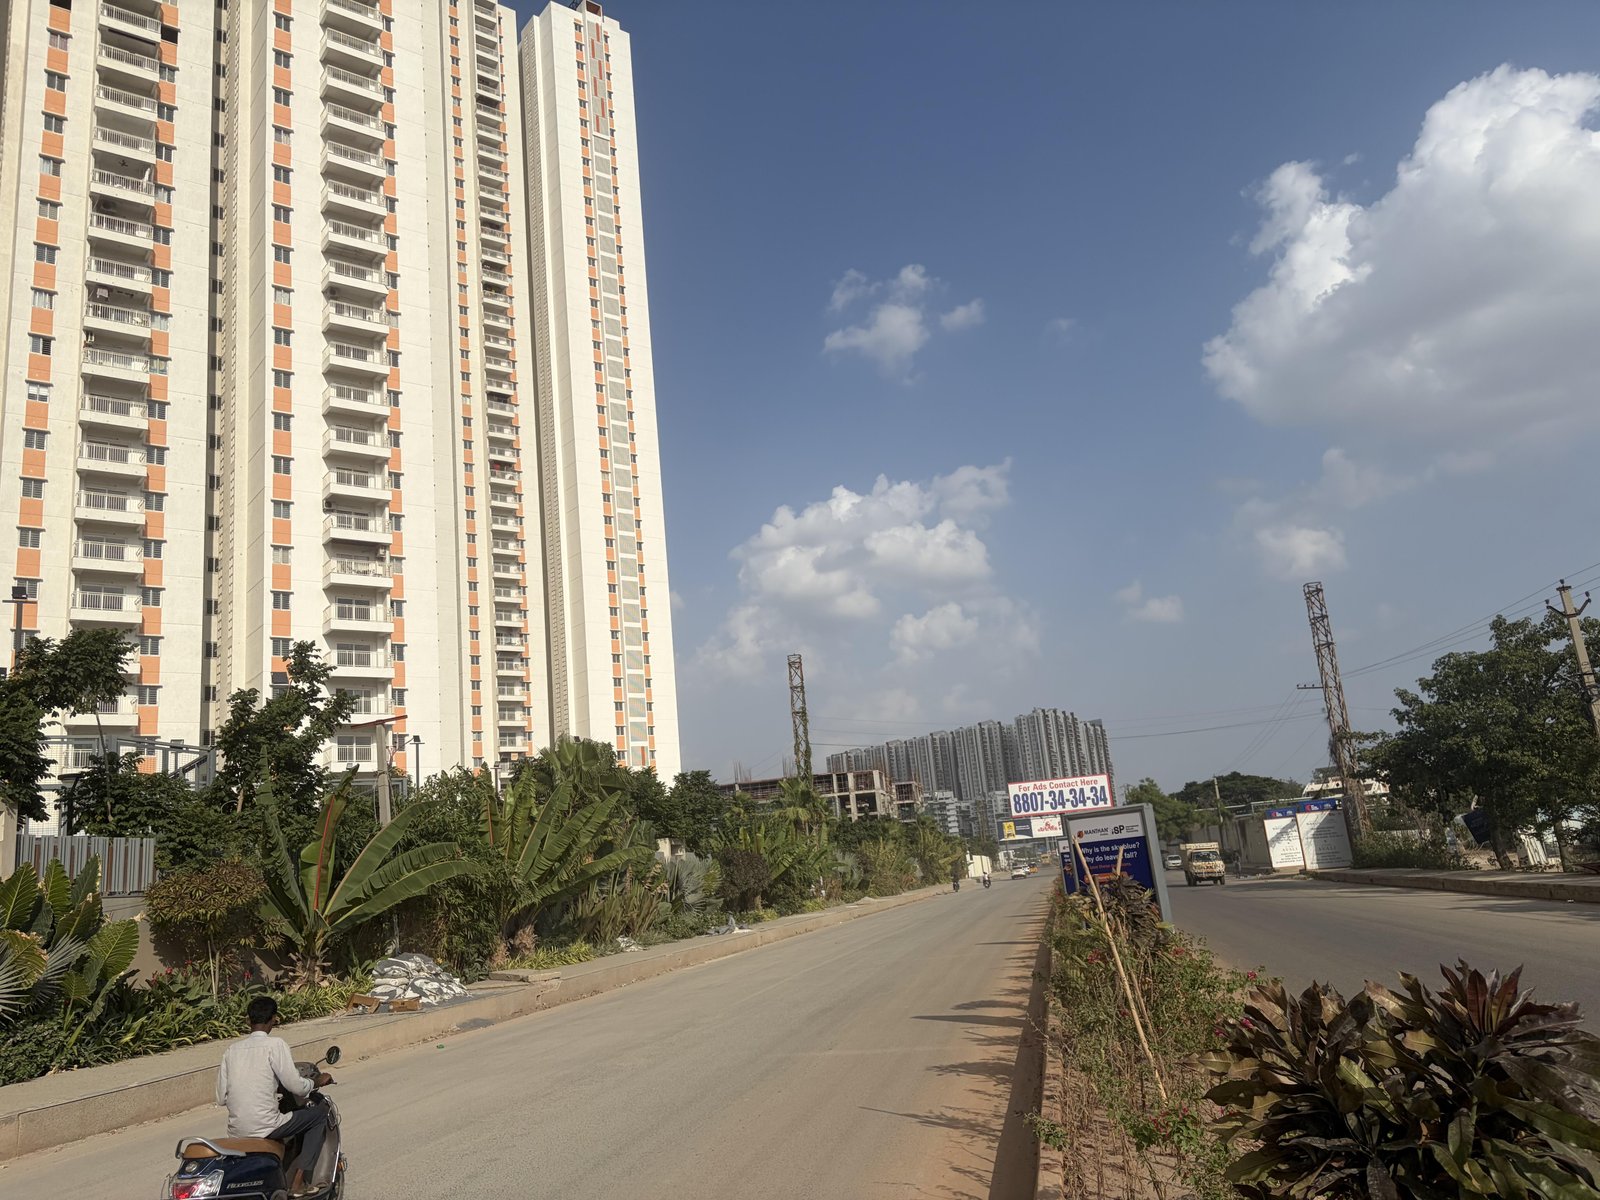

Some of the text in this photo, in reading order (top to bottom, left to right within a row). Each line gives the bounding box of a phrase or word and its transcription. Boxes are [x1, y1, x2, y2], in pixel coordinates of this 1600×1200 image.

[1018, 778, 1098, 792] For Ads Contact Here
[1013, 785, 1108, 813] 8807-34-34-34
[1123, 841, 1140, 850] blue?
[1124, 851, 1138, 859] fall?
